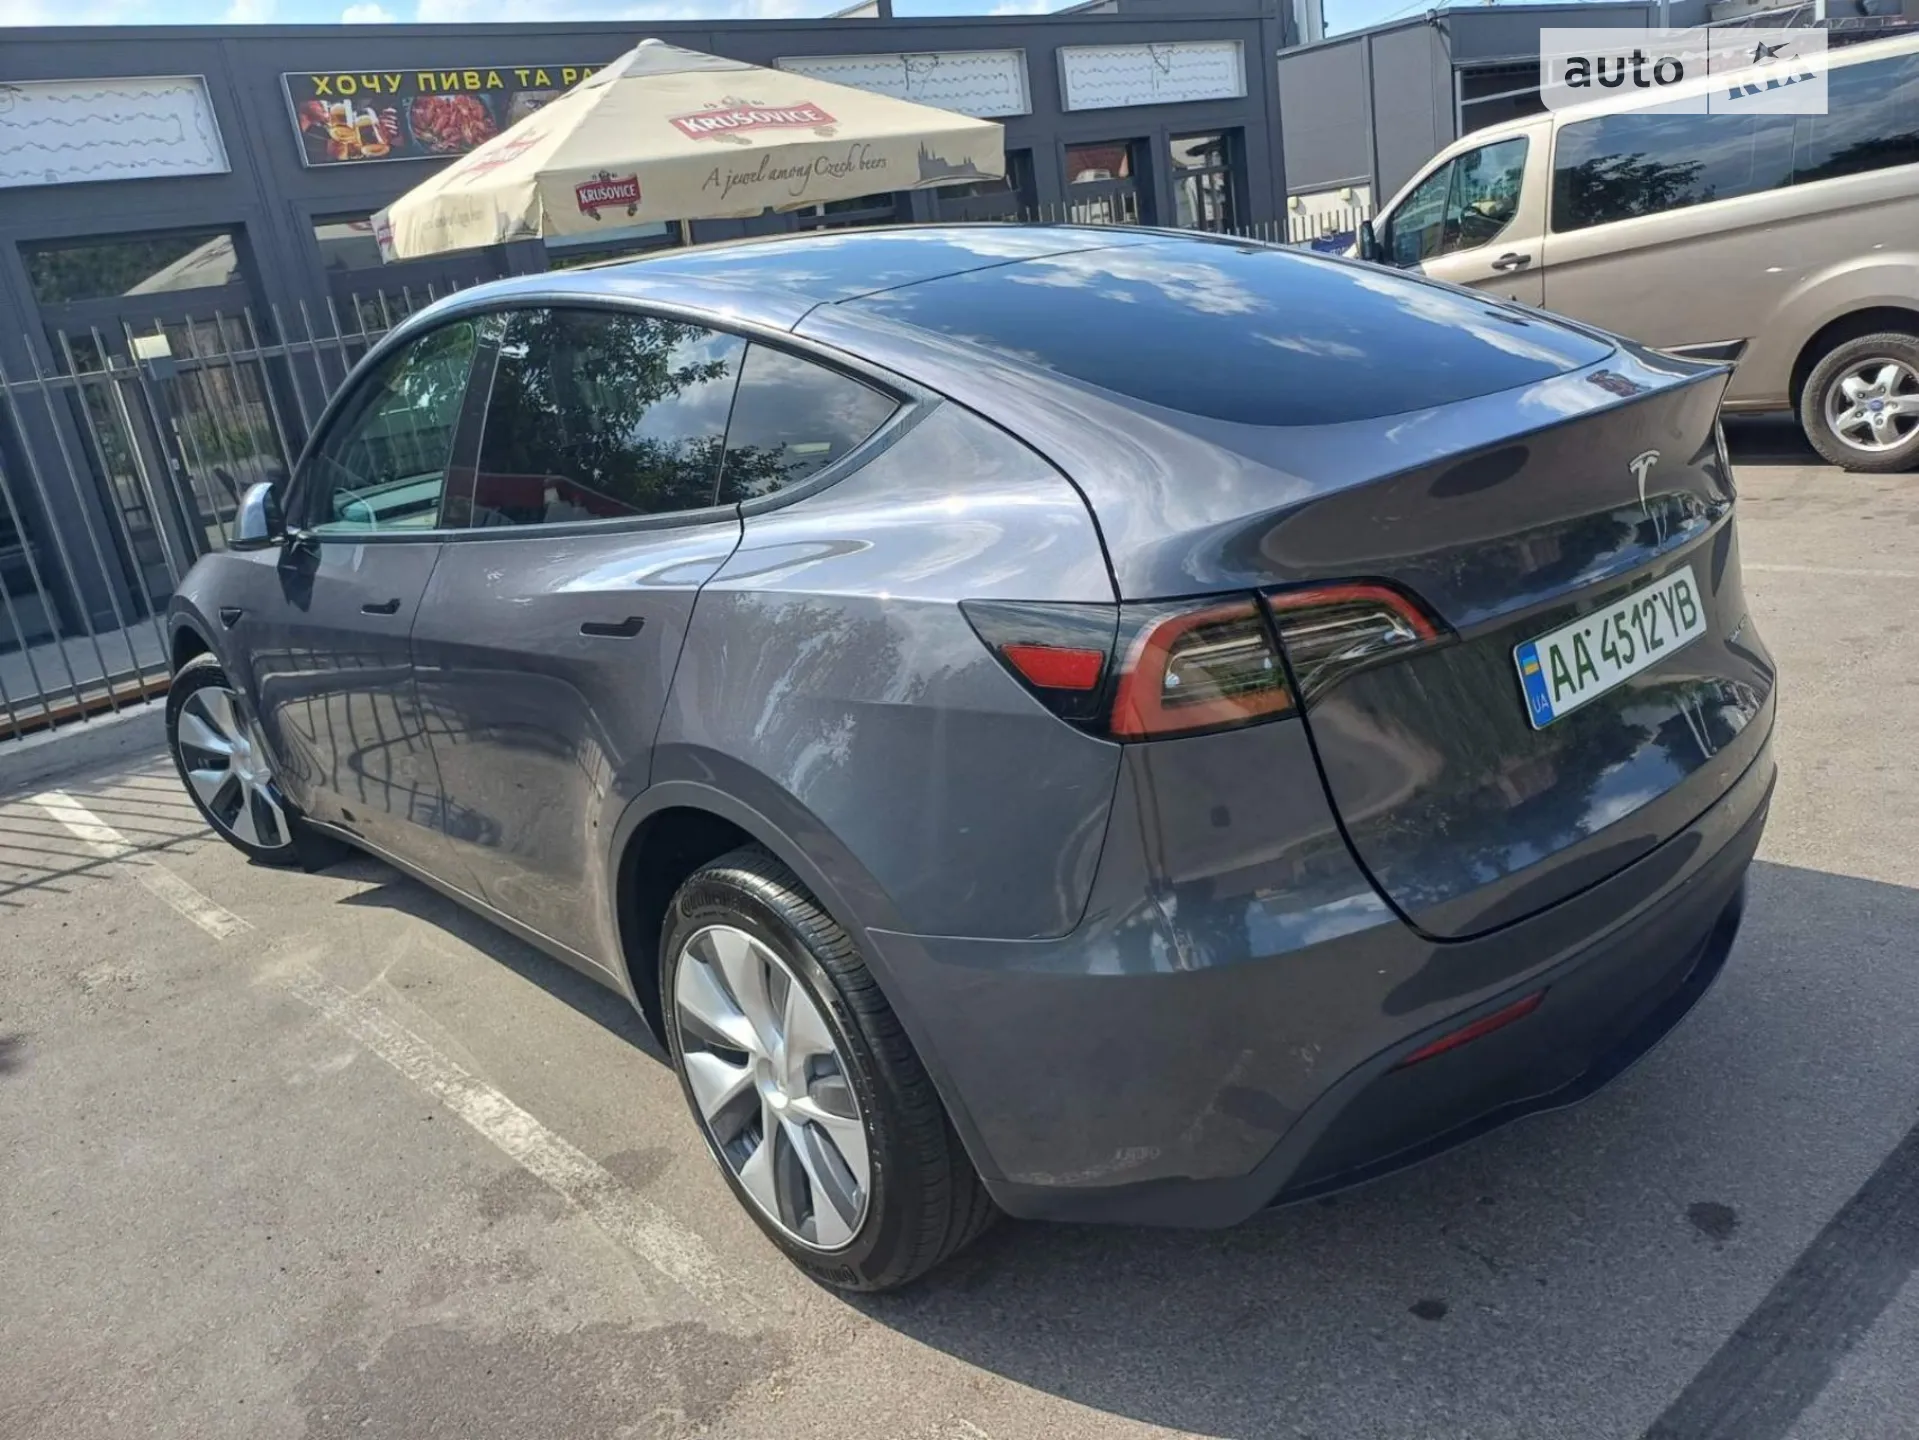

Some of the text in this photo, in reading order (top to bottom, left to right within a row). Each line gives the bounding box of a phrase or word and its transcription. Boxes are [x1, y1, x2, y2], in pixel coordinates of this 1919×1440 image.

[312, 74, 401, 95] ХОЧУ
[417, 69, 505, 92] ПИВА
[514, 67, 551, 88] ТА
[701, 143, 888, 200] A jewel among Czech beers
[1549, 631, 1600, 704] AA
[1600, 597, 1665, 670] 4512
[1532, 692, 1550, 714] UA
